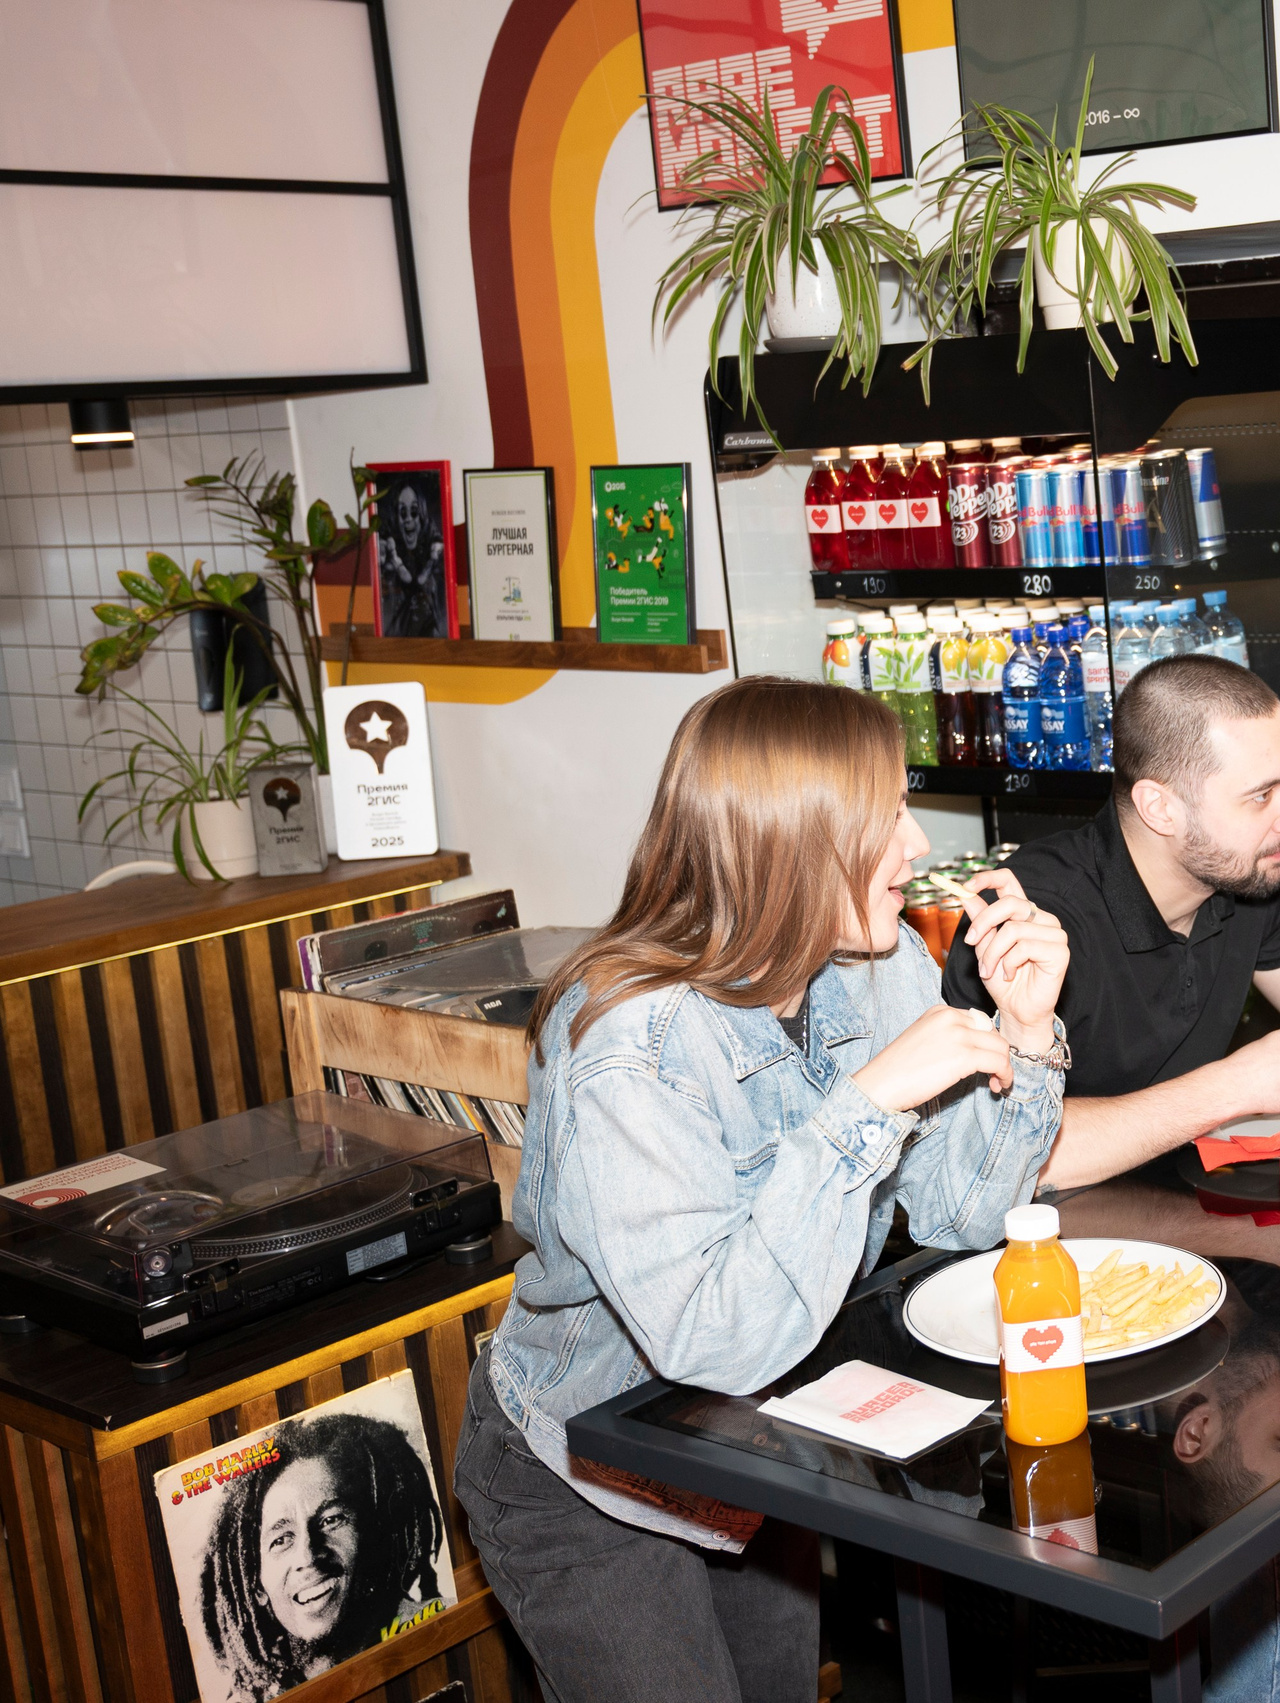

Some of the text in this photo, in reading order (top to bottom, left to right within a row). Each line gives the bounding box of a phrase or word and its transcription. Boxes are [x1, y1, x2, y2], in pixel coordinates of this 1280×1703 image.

[725, 436, 774, 446] Carboma
[956, 483, 979, 500] Dr
[1055, 504, 1076, 516] Bull
[1123, 502, 1144, 514] Bull
[491, 527, 528, 540] ЛУЧШАЯ
[955, 526, 967, 540] 23
[992, 524, 1004, 538] 23
[486, 543, 534, 556] БУРГЕРНАЯ
[863, 577, 886, 594] 190
[1023, 574, 1051, 596] 280
[1135, 575, 1160, 590] 250
[610, 586, 648, 597] Победитель
[908, 772, 926, 789] 00
[1005, 774, 1031, 792] 130
[357, 783, 409, 795] Премия
[367, 795, 401, 806] 2ГИС
[268, 826, 304, 835] Премия
[371, 836, 405, 847] 2025
[484, 1000, 502, 1010] RCA
[839, 1381, 914, 1420] BURGER
[849, 1386, 926, 1424] RECORDS
[181, 1436, 275, 1486] BOB MARLEY
[171, 1447, 281, 1505] & THE WAILERS
